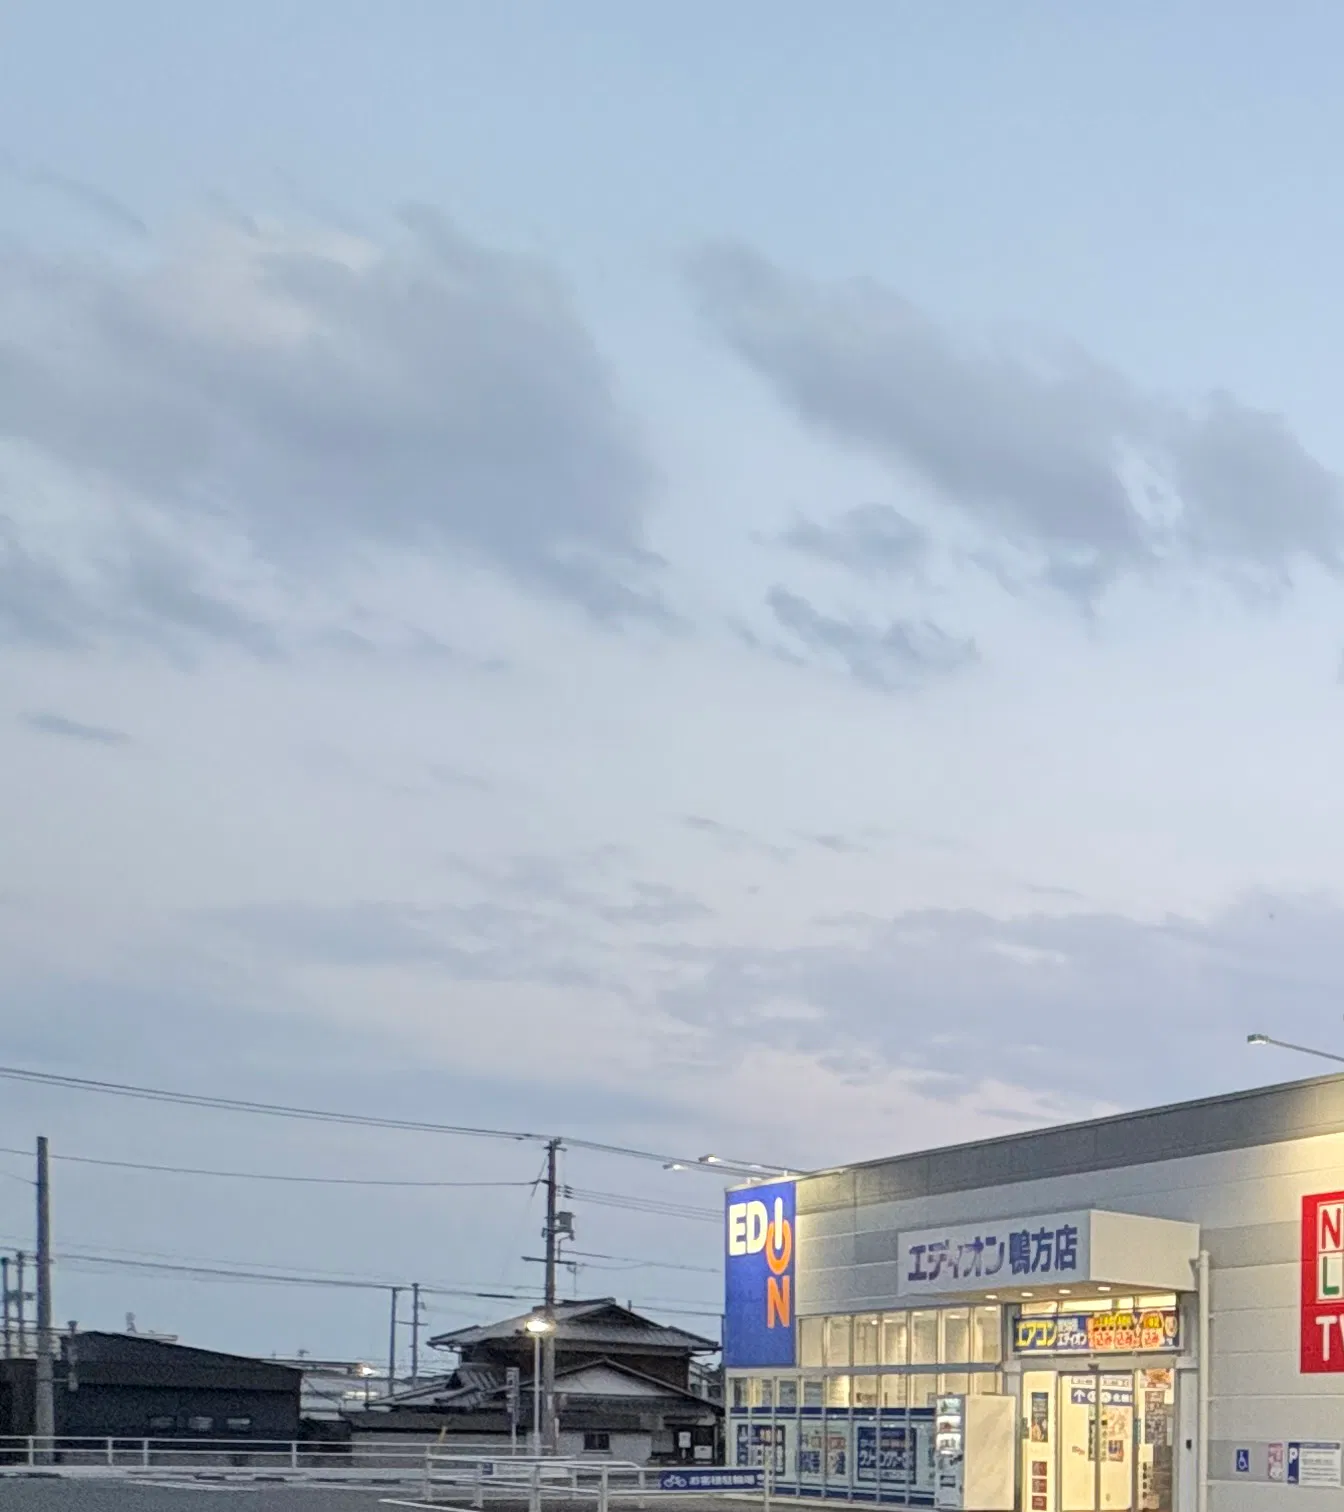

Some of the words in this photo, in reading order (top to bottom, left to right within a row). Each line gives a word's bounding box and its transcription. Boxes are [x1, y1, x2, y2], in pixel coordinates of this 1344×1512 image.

[1016, 1320, 1057, 1347] エアコン
[1288, 1447, 1298, 1464] P
